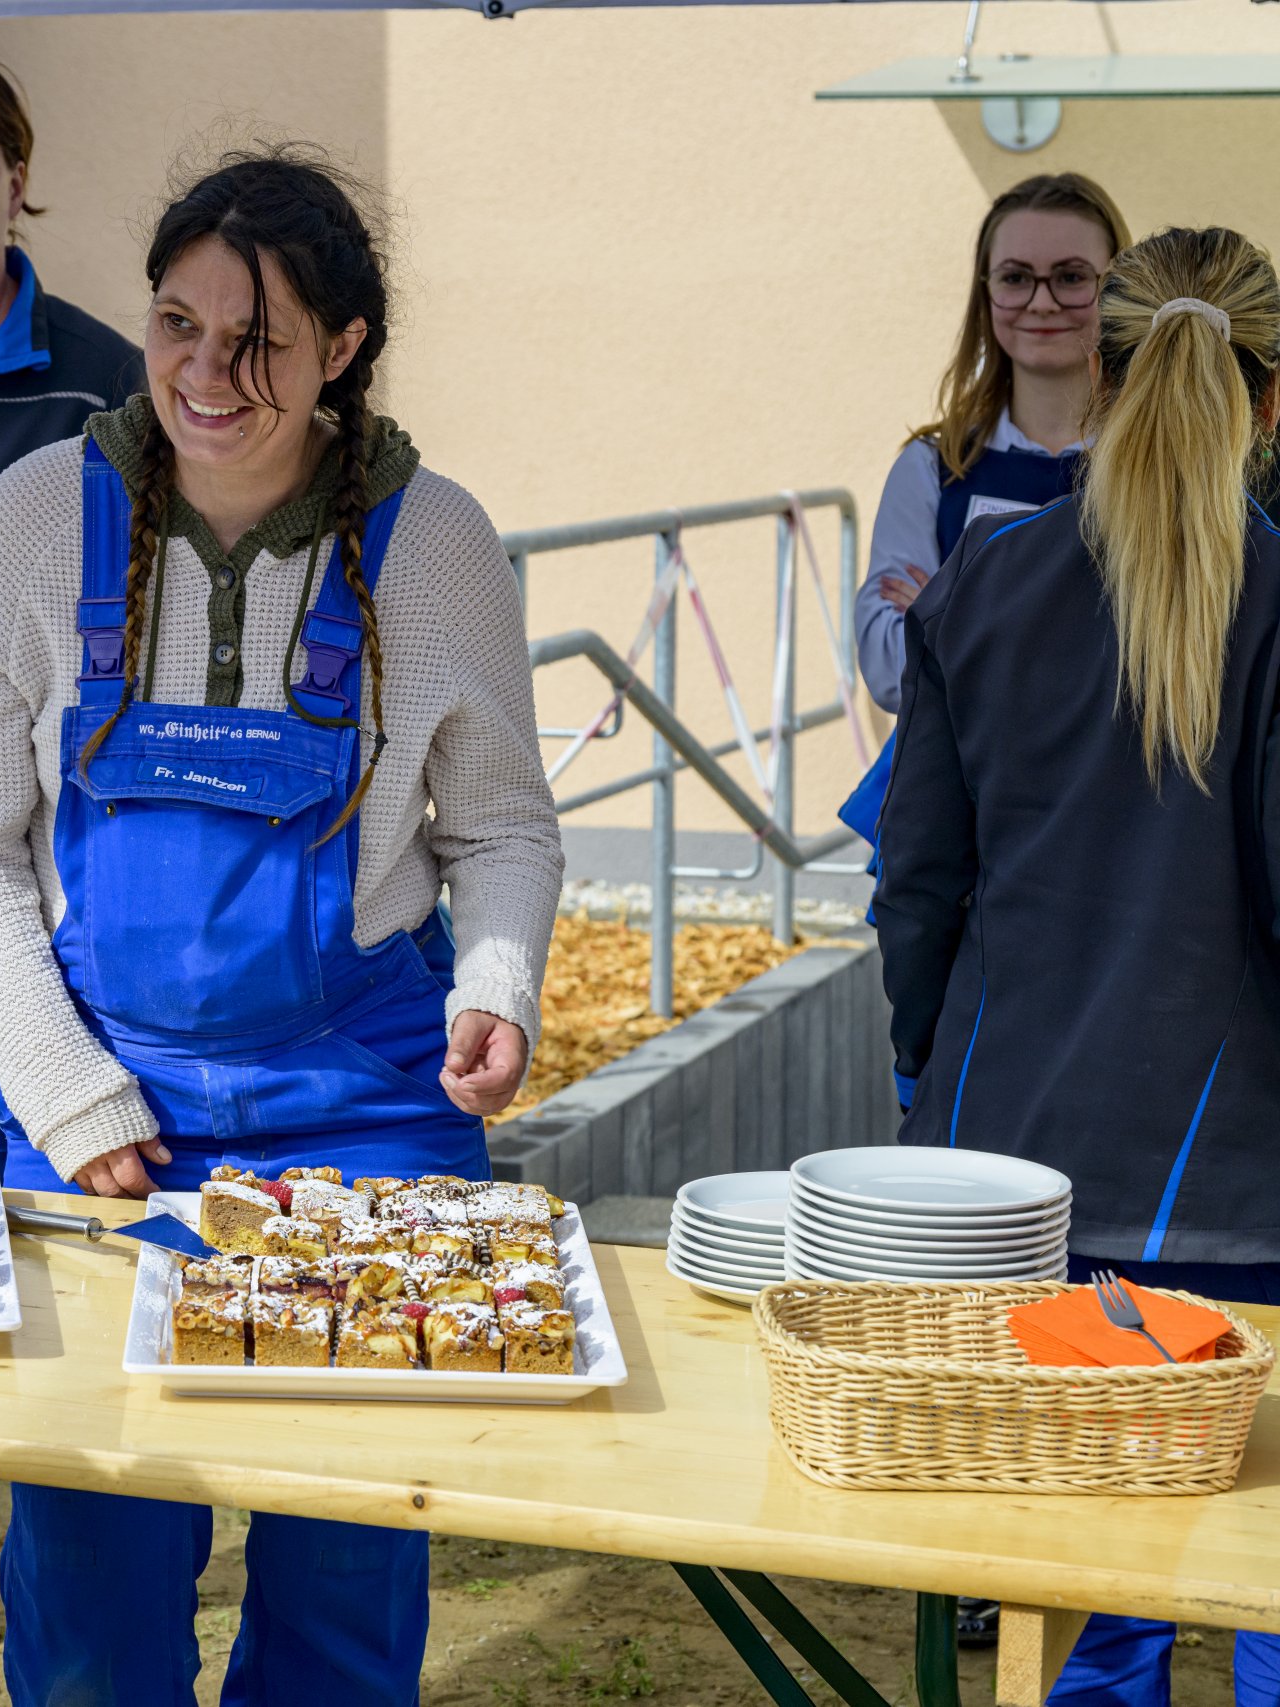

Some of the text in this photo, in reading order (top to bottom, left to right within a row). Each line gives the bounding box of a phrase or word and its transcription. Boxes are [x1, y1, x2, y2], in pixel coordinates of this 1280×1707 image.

[139, 724, 155, 735] WG
[230, 730, 243, 739] eG
[245, 730, 281, 741] BERNAU
[154, 766, 247, 793] Fr. Jantzen
